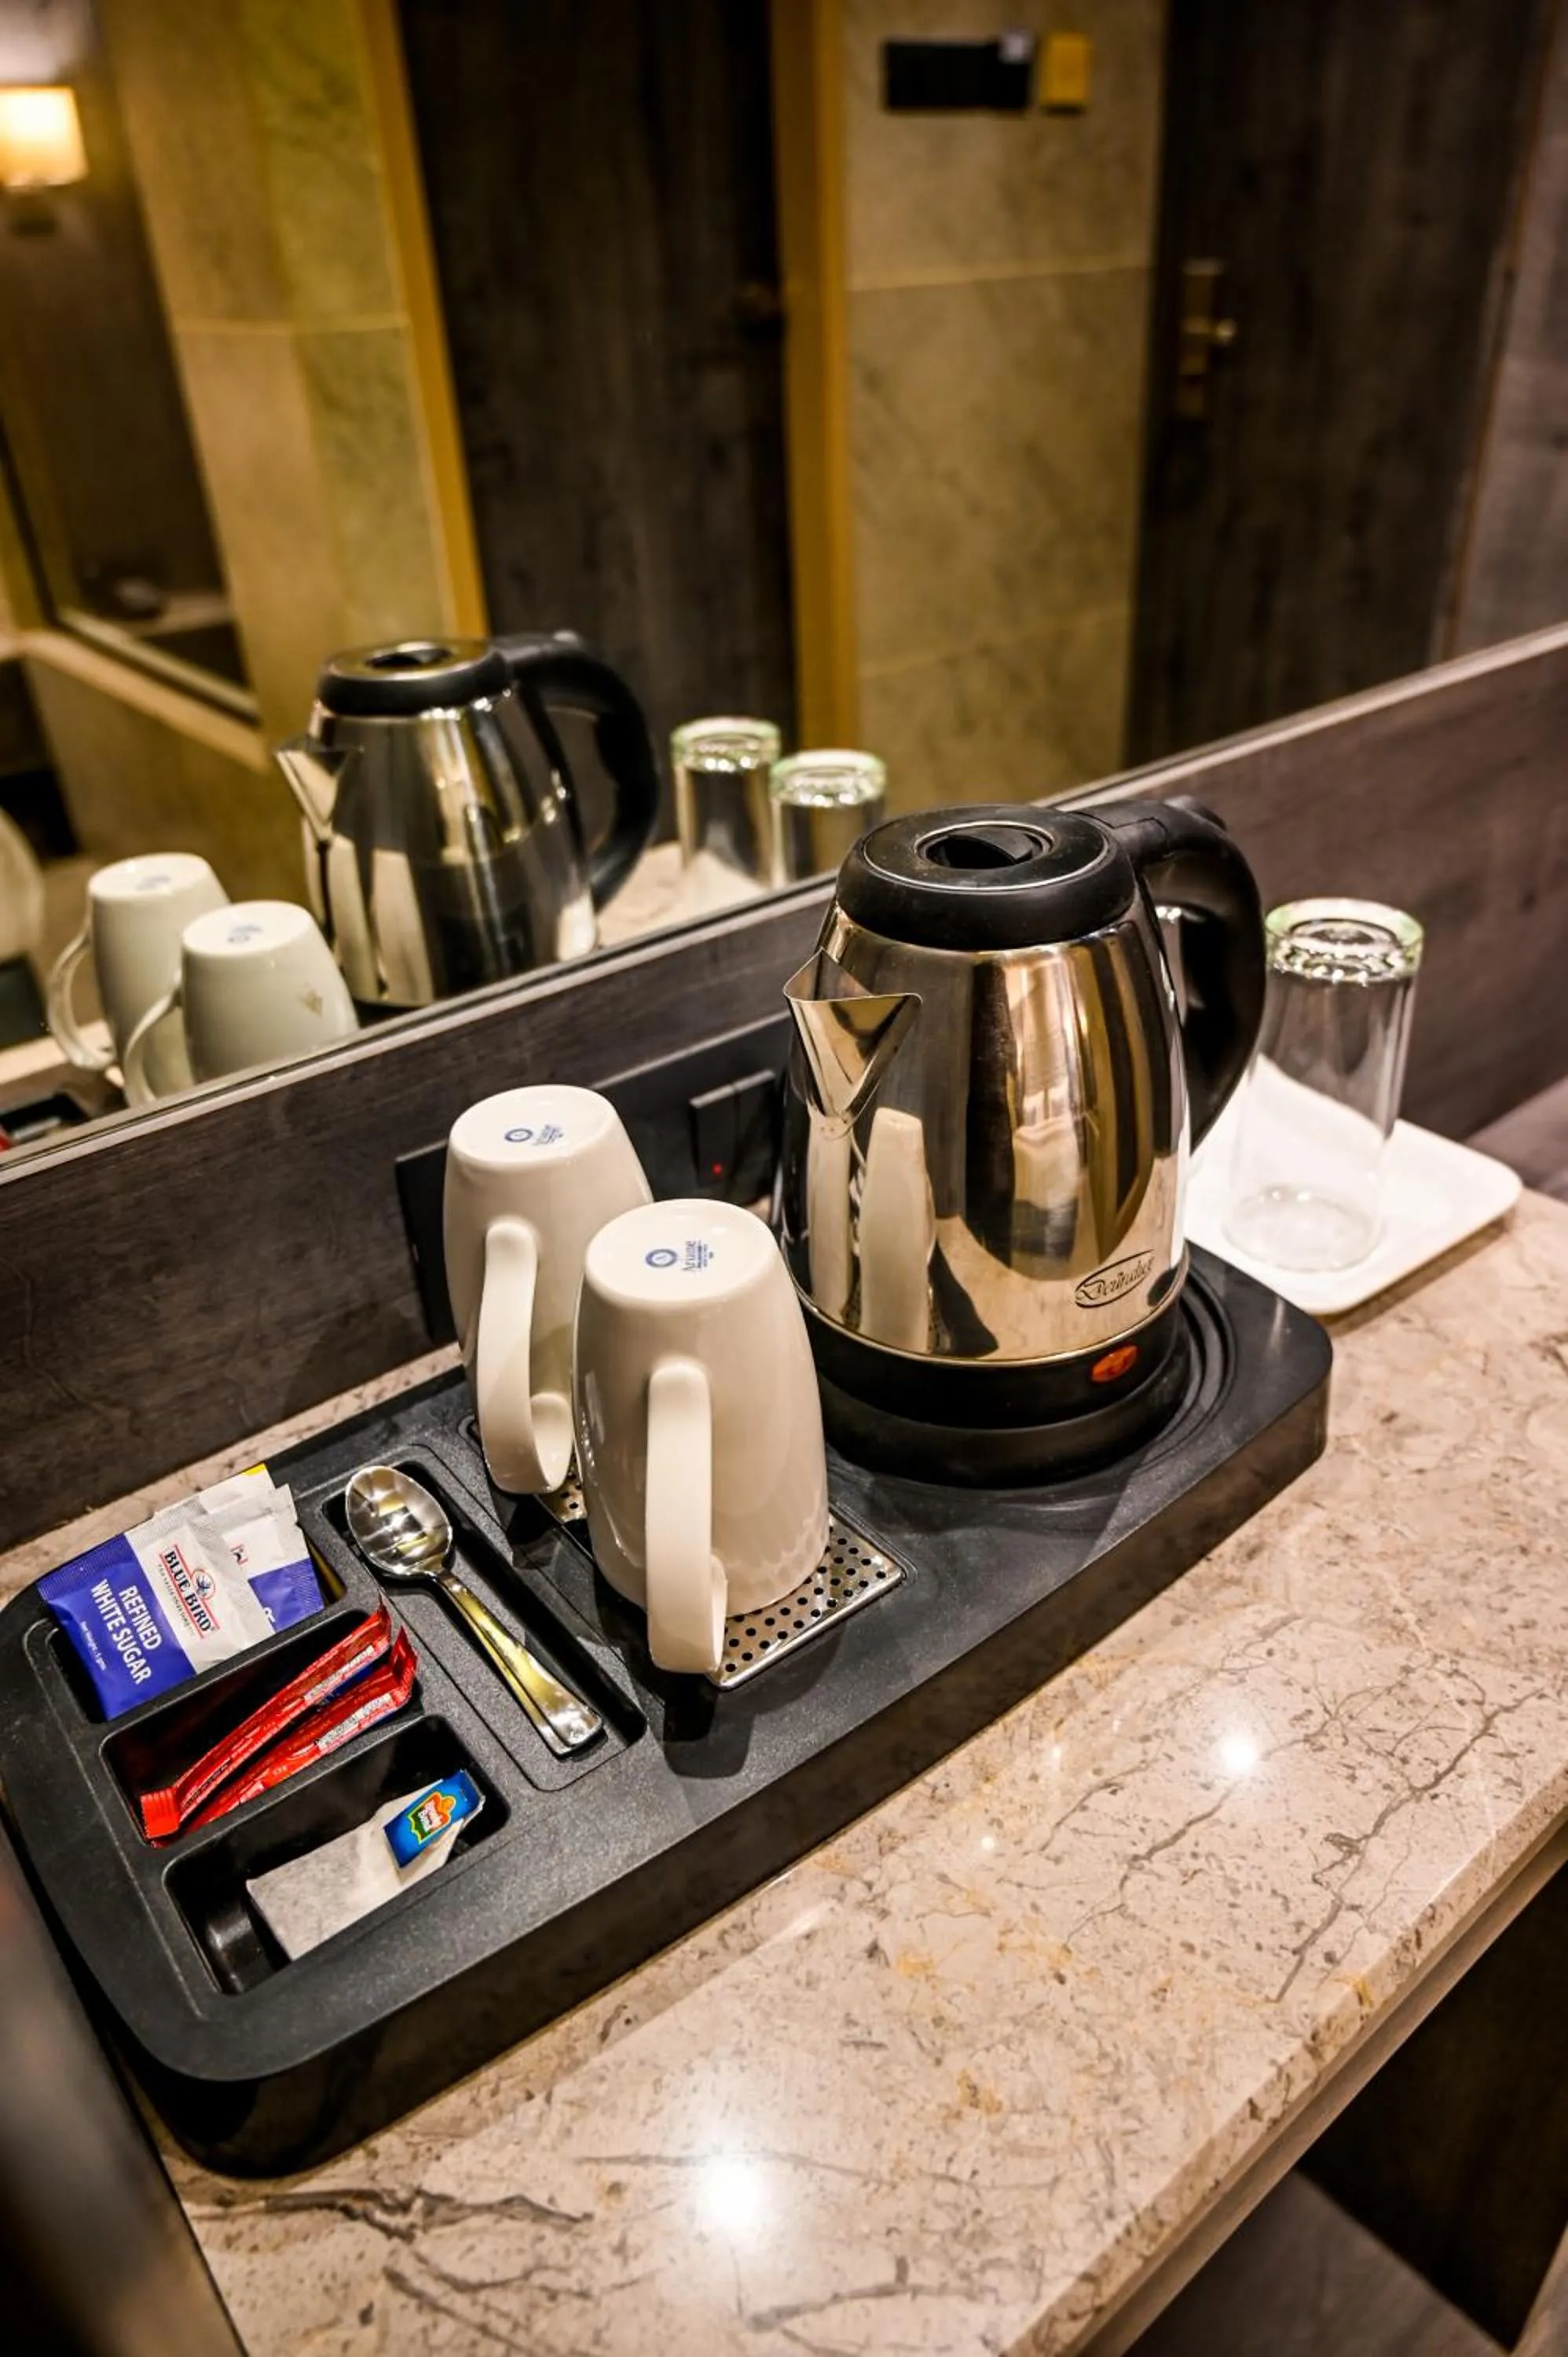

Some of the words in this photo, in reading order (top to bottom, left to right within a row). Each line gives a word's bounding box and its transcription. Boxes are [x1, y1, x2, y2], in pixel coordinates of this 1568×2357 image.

[90, 1578, 126, 1632] WHITE
[112, 1627, 152, 1685] SUGAR
[119, 1585, 163, 1650] REFINED
[164, 1551, 191, 1592] BLUE
[185, 1593, 211, 1632] BIRD
